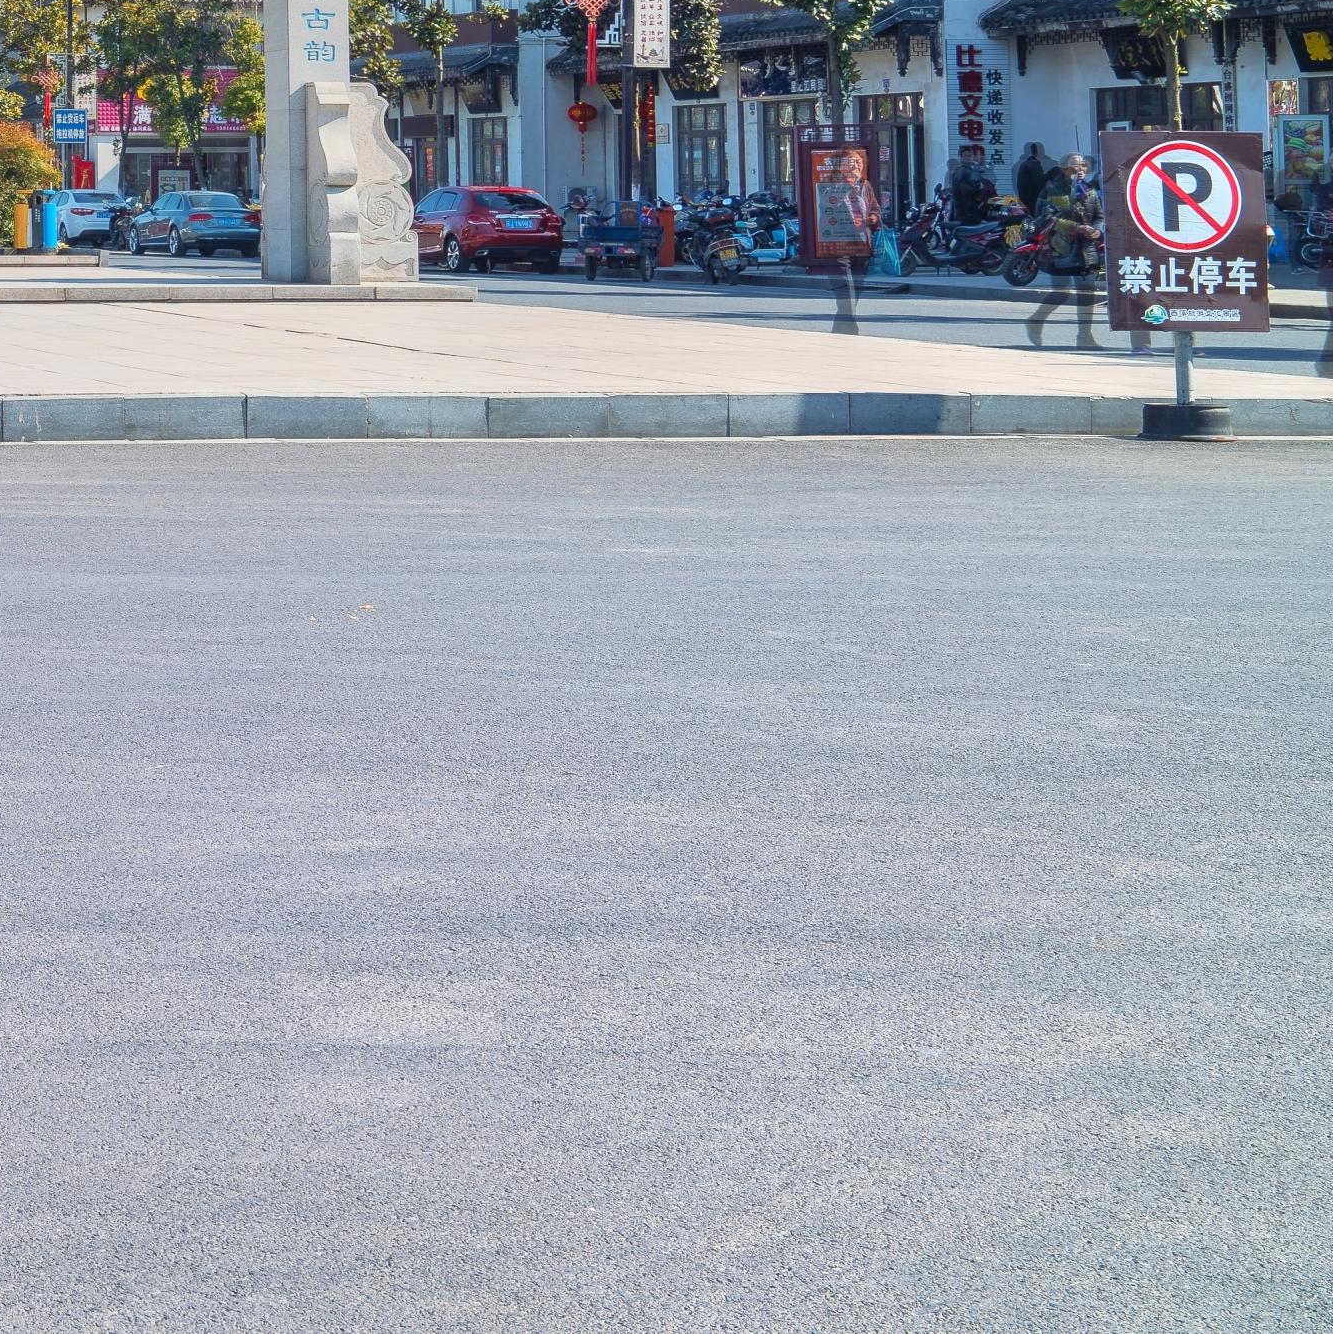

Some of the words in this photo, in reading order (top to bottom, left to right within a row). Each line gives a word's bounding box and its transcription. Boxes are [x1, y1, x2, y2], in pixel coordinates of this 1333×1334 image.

[986, 69, 1005, 165] 快递收发点
[1118, 256, 1257, 295] 禁止停车
